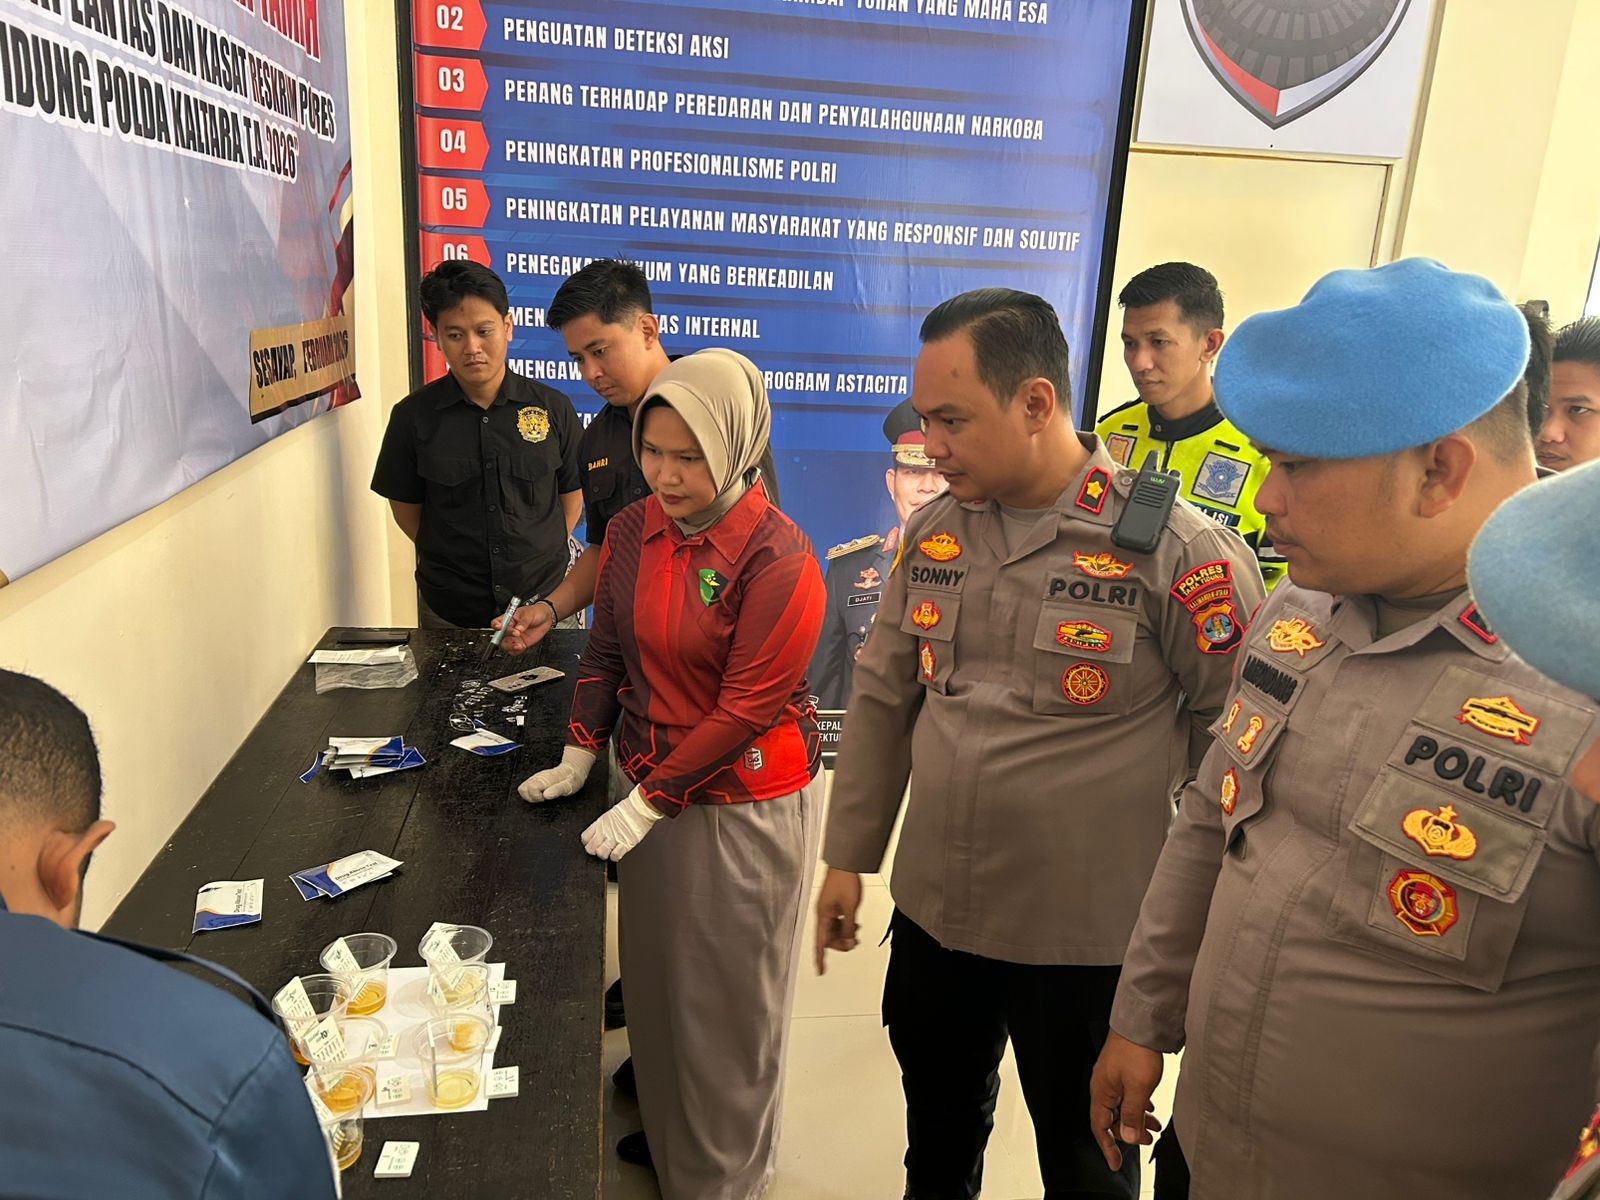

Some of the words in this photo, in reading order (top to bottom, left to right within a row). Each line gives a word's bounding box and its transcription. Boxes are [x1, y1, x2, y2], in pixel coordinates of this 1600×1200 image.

[437, 5, 463, 31] 02
[916, 0, 958, 16] YANG
[963, 0, 1012, 22] MAHA
[1018, 1, 1047, 25] ESA
[504, 17, 607, 49] PENGUATAN
[614, 28, 683, 55] DETEKSI
[690, 34, 729, 59] AKSI
[157, 1, 197, 77] DAN
[197, 23, 248, 98] KASAT
[248, 51, 299, 123] RESKRIM
[438, 67, 465, 93] 03
[96, 58, 171, 145] POLDA
[243, 115, 268, 170] T.A.
[505, 79, 573, 106] PERANG
[580, 85, 669, 113] TERHADAP
[675, 93, 773, 121] PEREDARAN
[779, 101, 812, 124] DAN
[818, 104, 965, 136] PENYALAHGUNAAN
[971, 115, 1043, 140] NARKOBA
[440, 128, 467, 154] 04
[505, 140, 624, 170] PENINGKATAN
[630, 149, 784, 181] PROFESIONALISME
[790, 159, 837, 184] POLRI
[441, 187, 468, 211] 05
[506, 197, 623, 226] PENINGKATAN
[629, 204, 724, 232] PELAYANAN
[731, 211, 841, 239] MASYARAKAT
[847, 219, 888, 242] YANG
[893, 222, 978, 248] RESPONSIF
[983, 227, 1014, 249] DAN
[1019, 229, 1081, 252] SOLUTIF
[443, 242, 469, 261] 06
[507, 253, 602, 275] PENEGAKA
[614, 259, 671, 282] KUM
[678, 263, 721, 285] YANG
[726, 265, 834, 291] BERKEADILAN
[508, 306, 547, 327] MEN
[685, 316, 761, 338] INTERNAL
[509, 359, 582, 381] MENGAW
[836, 374, 907, 395] ASTACITA
[911, 566, 964, 588] SONNY
[1178, 564, 1223, 592] POLRES
[855, 595, 873, 603] DJATI
[1050, 578, 1137, 606] POLRI
[816, 720, 843, 731] KEPAL
[819, 732, 842, 742] EKTU
[1404, 735, 1542, 813] POLRI
